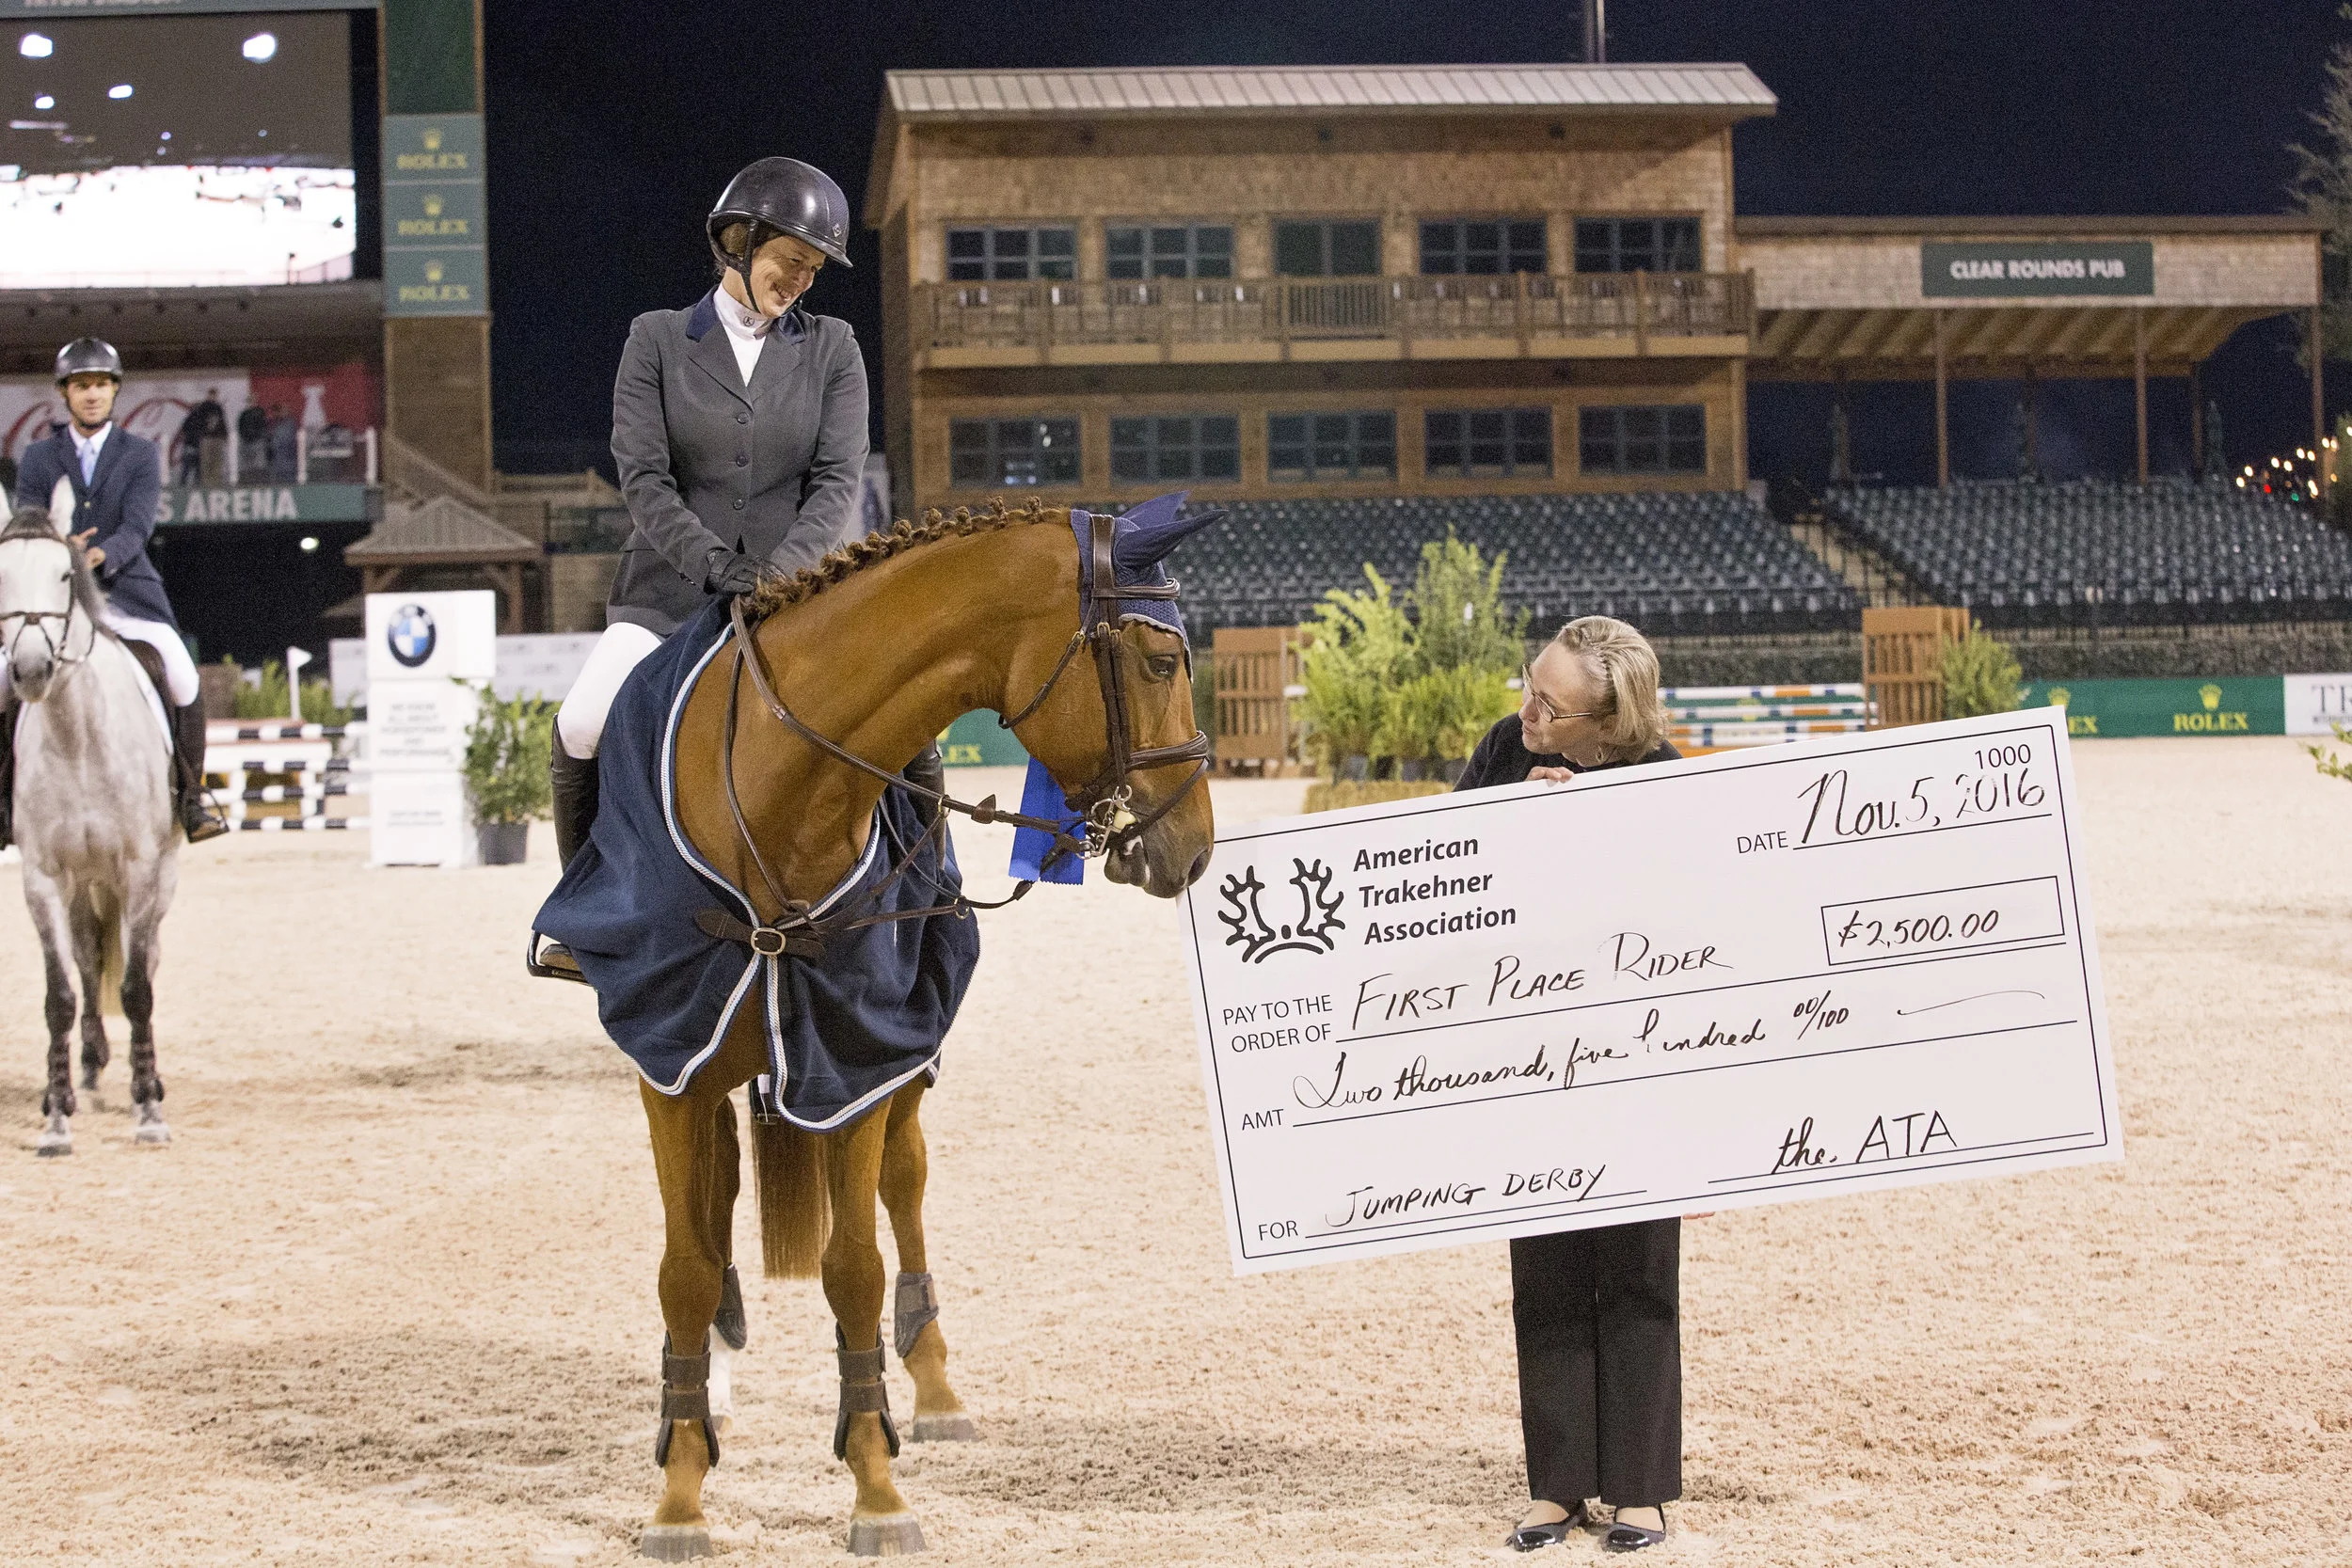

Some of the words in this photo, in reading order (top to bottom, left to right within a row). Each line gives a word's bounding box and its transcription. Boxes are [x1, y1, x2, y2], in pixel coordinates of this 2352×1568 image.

[1949, 260, 2005, 278] CLEAR
[2008, 260, 2086, 278] ROUNDS
[2089, 259, 2126, 278] PUB
[184, 487, 297, 522] ARENA
[2174, 712, 2249, 732] ROLEX
[1975, 744, 2032, 769] 1000
[1798, 769, 1900, 844] Nov.
[1905, 777, 1941, 827] 5,
[1955, 768, 2045, 818] 2016
[1353, 838, 1479, 872] American
[1737, 831, 1788, 854] DATE
[1359, 873, 1493, 908] Trakehner
[1364, 908, 1517, 944] Association
[1838, 910, 1999, 948] $2,500.00
[1352, 973, 1470, 1030] FIRST
[1487, 955, 1585, 1006] PLACE
[1597, 931, 1734, 982] RIDER
[1223, 1004, 1257, 1025] PAY
[1261, 1001, 1290, 1019] TO
[1293, 994, 1333, 1015] THE
[1231, 1028, 1299, 1053] ORDER
[1304, 1022, 1332, 1042] OF
[1293, 1051, 1382, 1108] Two
[1564, 1037, 1629, 1090] five
[1242, 1108, 1284, 1131] AMT
[1856, 1110, 1958, 1164] ATA
[1325, 1182, 1486, 1227] JUMPING
[1502, 1164, 1607, 1202] DERBY
[1258, 1220, 1299, 1242] FOR
